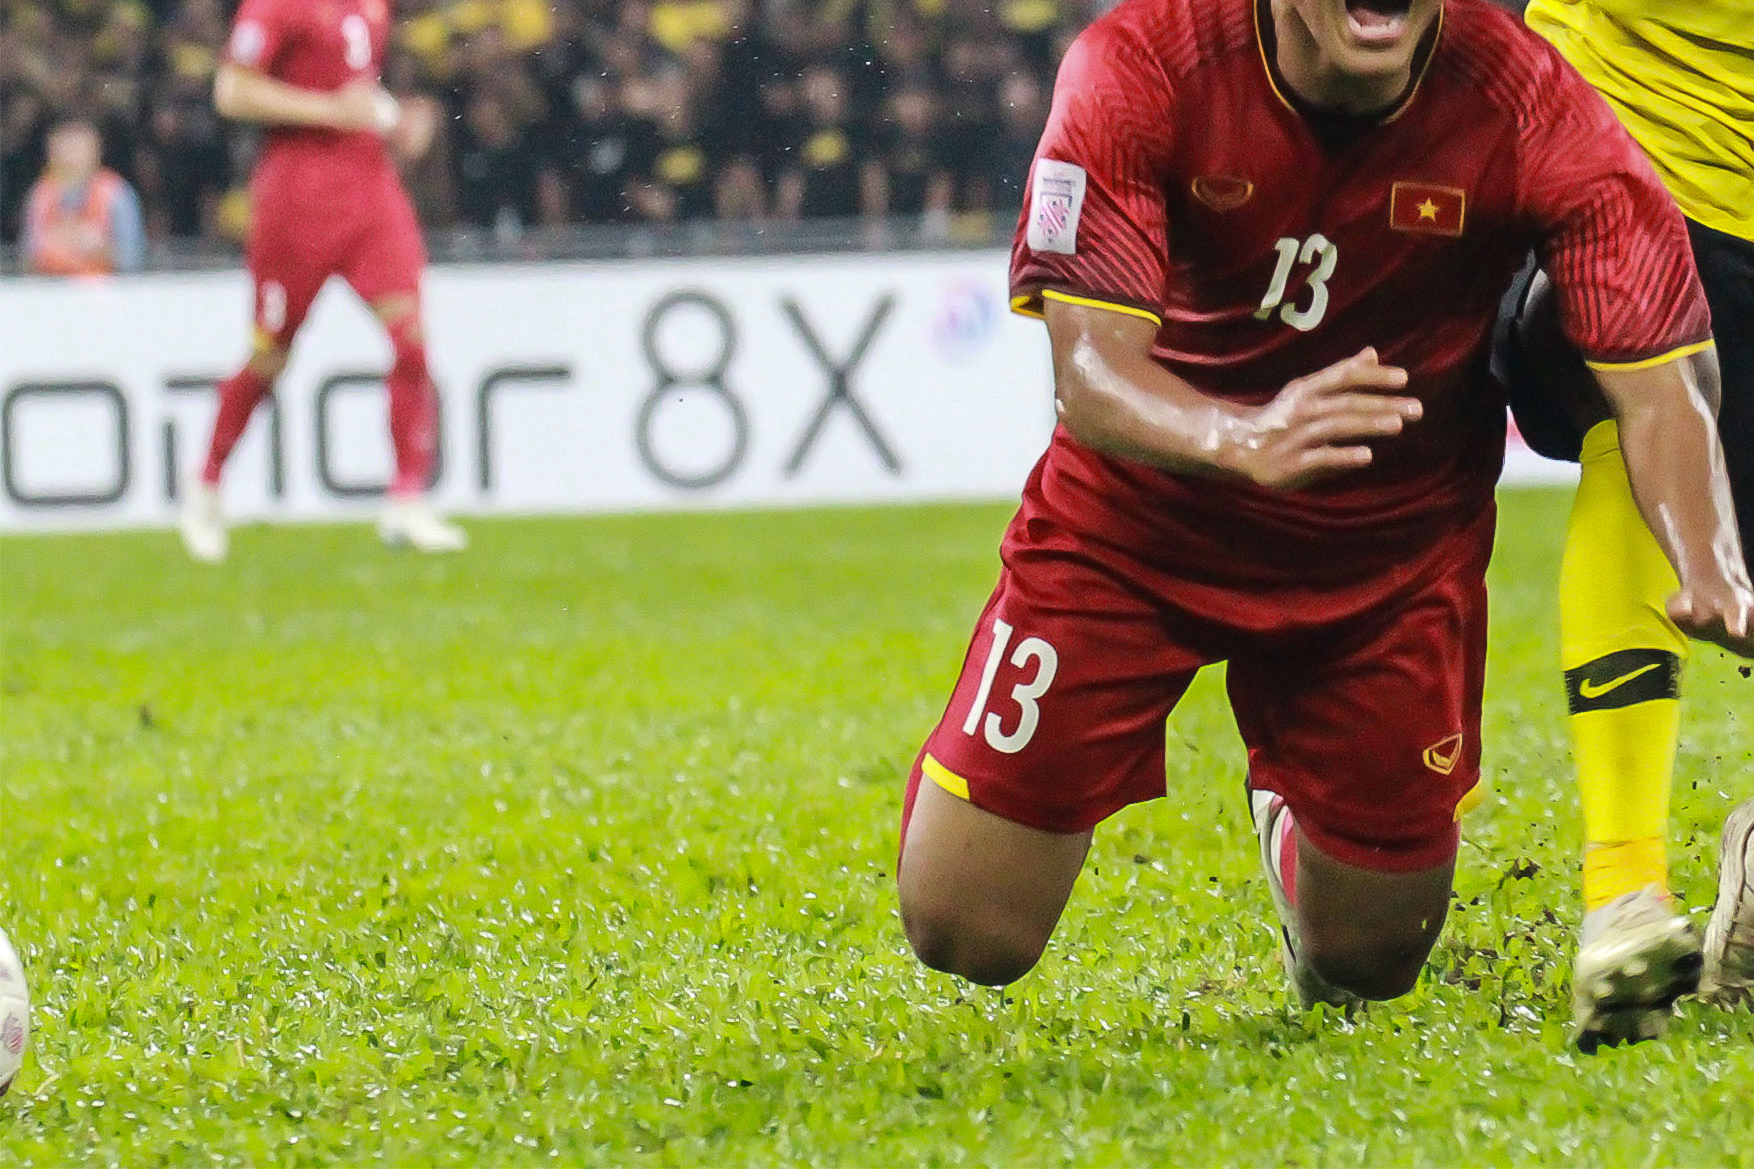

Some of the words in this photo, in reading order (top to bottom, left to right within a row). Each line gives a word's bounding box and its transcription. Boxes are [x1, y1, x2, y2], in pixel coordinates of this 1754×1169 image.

[1253, 233, 1338, 331] 13
[634, 288, 902, 488] 8X
[962, 617, 1058, 754] 13
